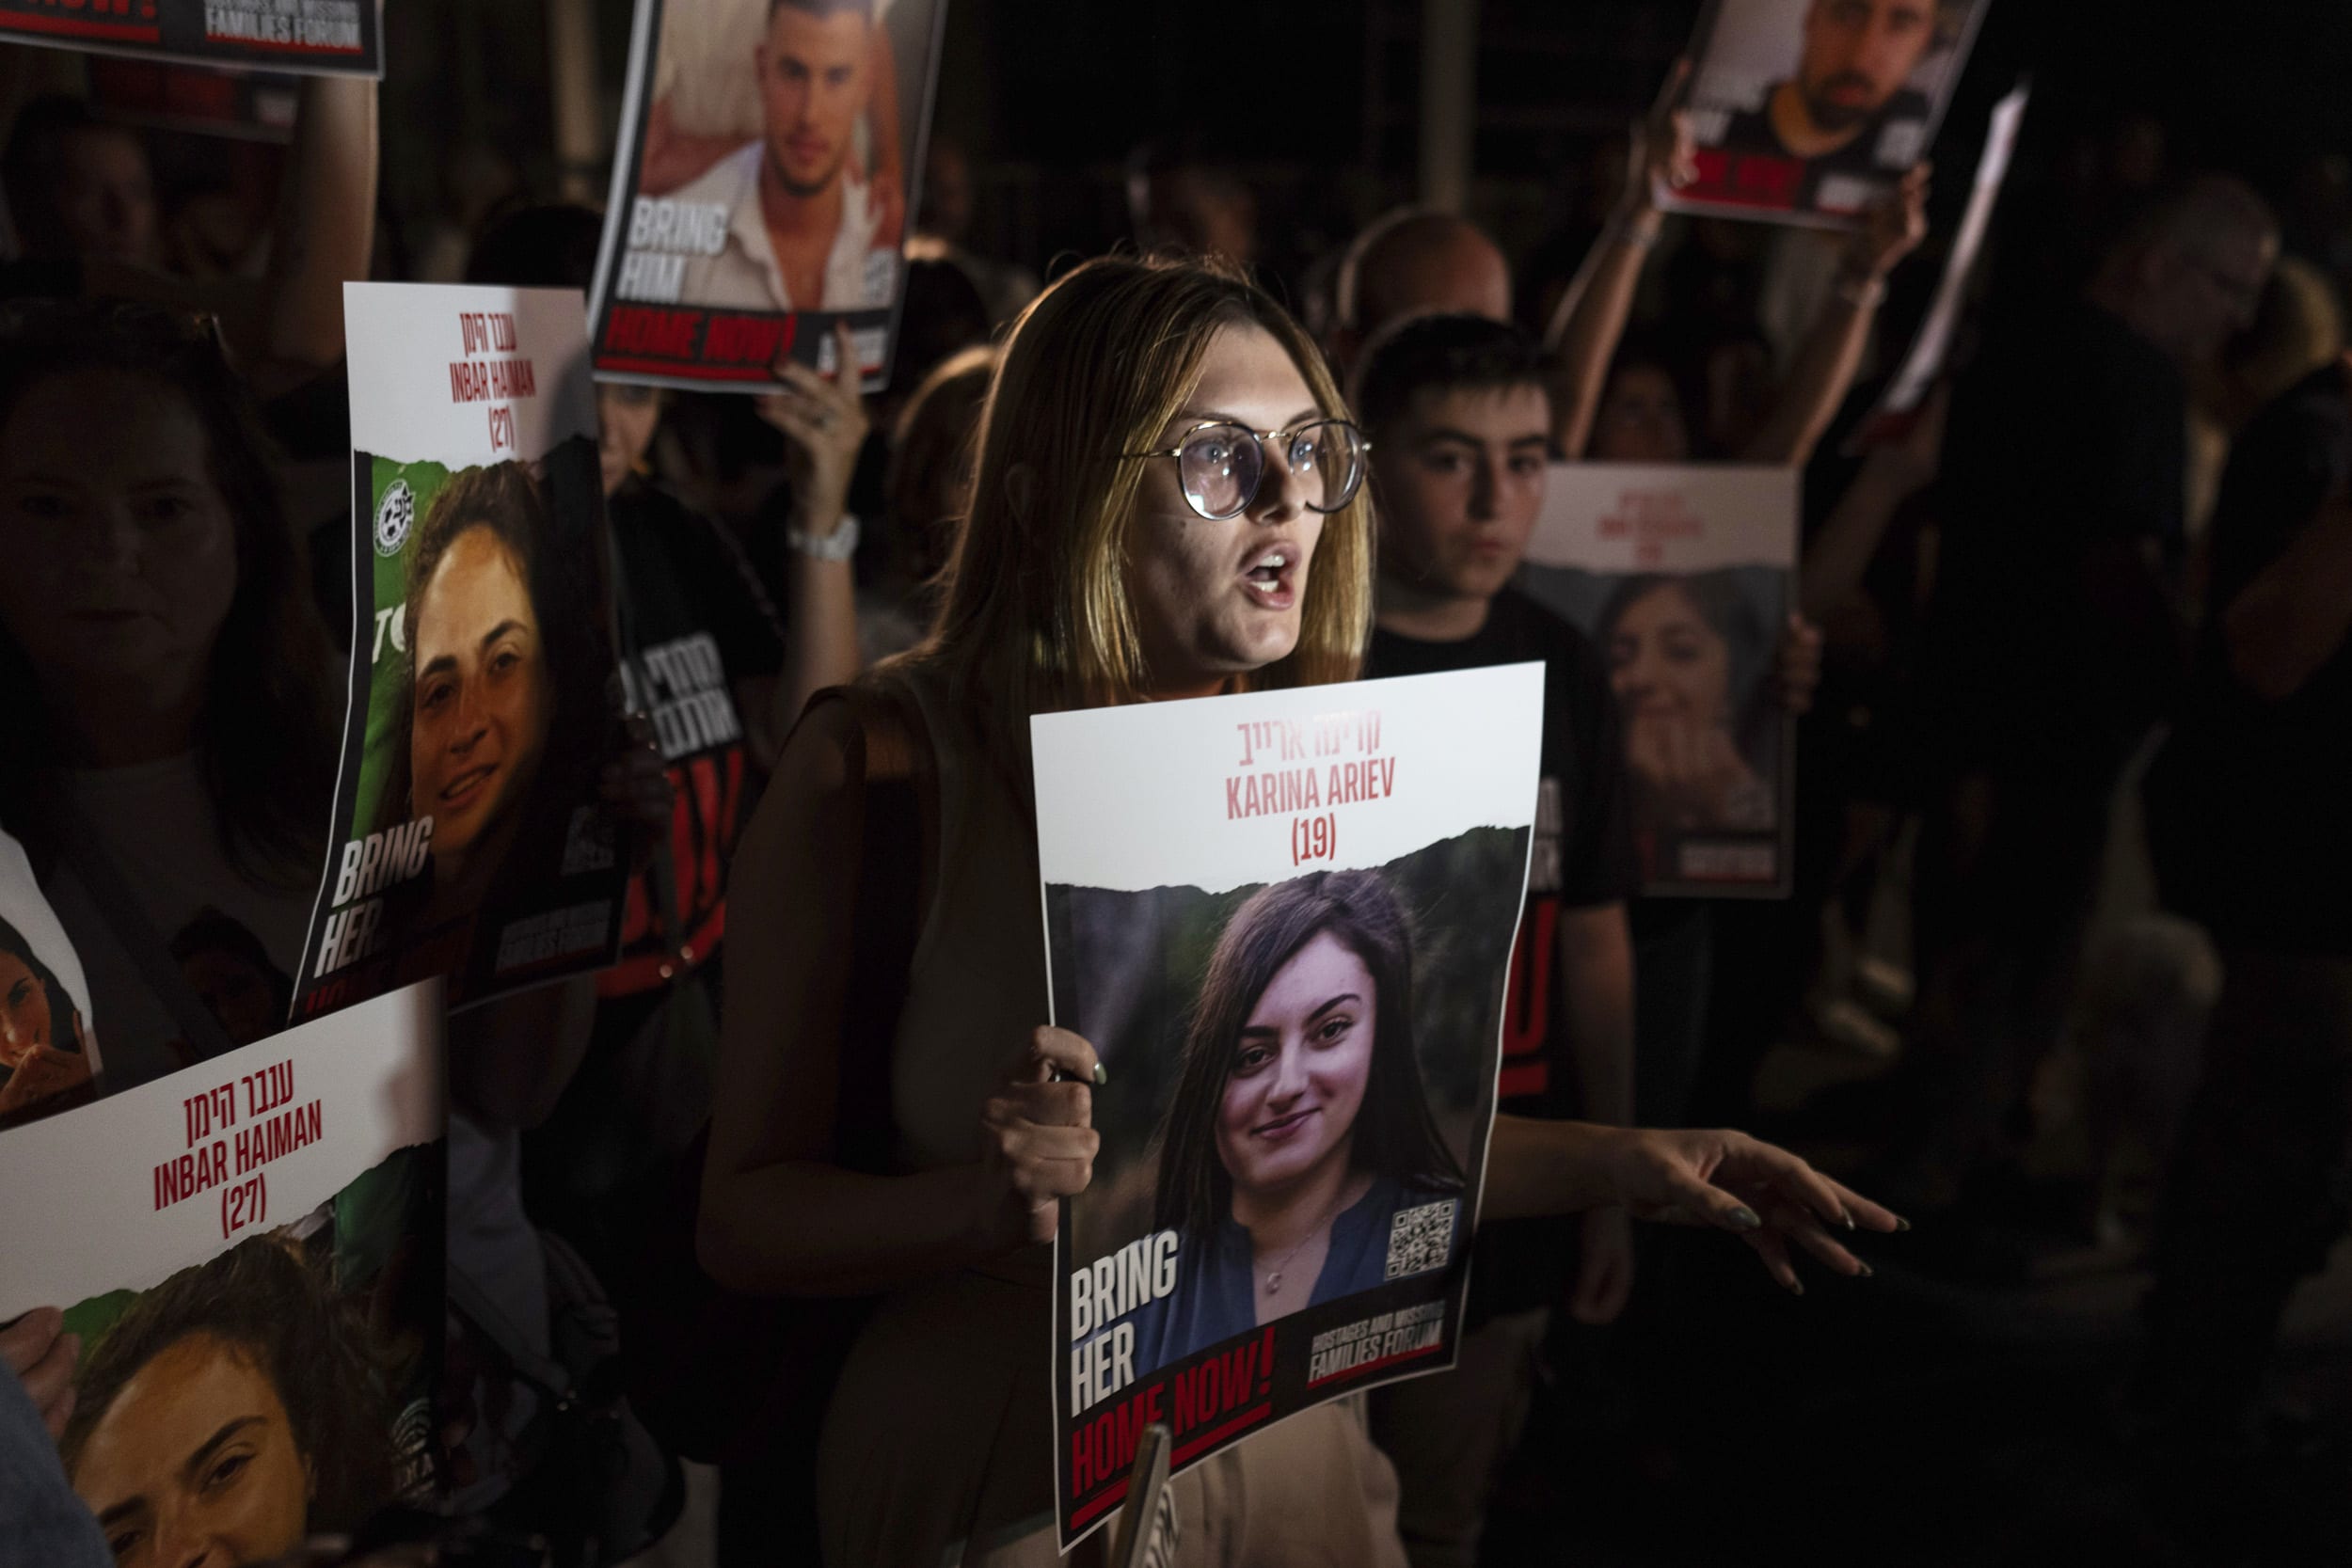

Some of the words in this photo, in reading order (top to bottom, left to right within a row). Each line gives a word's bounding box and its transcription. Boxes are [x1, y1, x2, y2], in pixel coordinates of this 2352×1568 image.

[629, 198, 729, 257] BRING
[450, 361, 491, 404] INBAR
[489, 359, 536, 400] HAIMAN
[488, 405, 515, 452] (27)
[1226, 767, 1321, 820] KARINA
[1327, 756, 1395, 806] ARIEV
[331, 815, 434, 909] BRING
[1292, 812, 1336, 866] (19)
[313, 895, 384, 979] HER
[183, 1081, 235, 1149] הימן
[241, 1058, 294, 1118] ענבר
[153, 1140, 229, 1212] INBAR
[234, 1098, 323, 1177] HAIMAN
[221, 1172, 267, 1241] (27)
[1071, 1230, 1179, 1342] BRING
[1071, 1321, 1135, 1418] HER
[1173, 1325, 1275, 1437] NOW!
[1308, 1335, 1382, 1384] FAMILIES
[1381, 1319, 1444, 1360] FORUM
